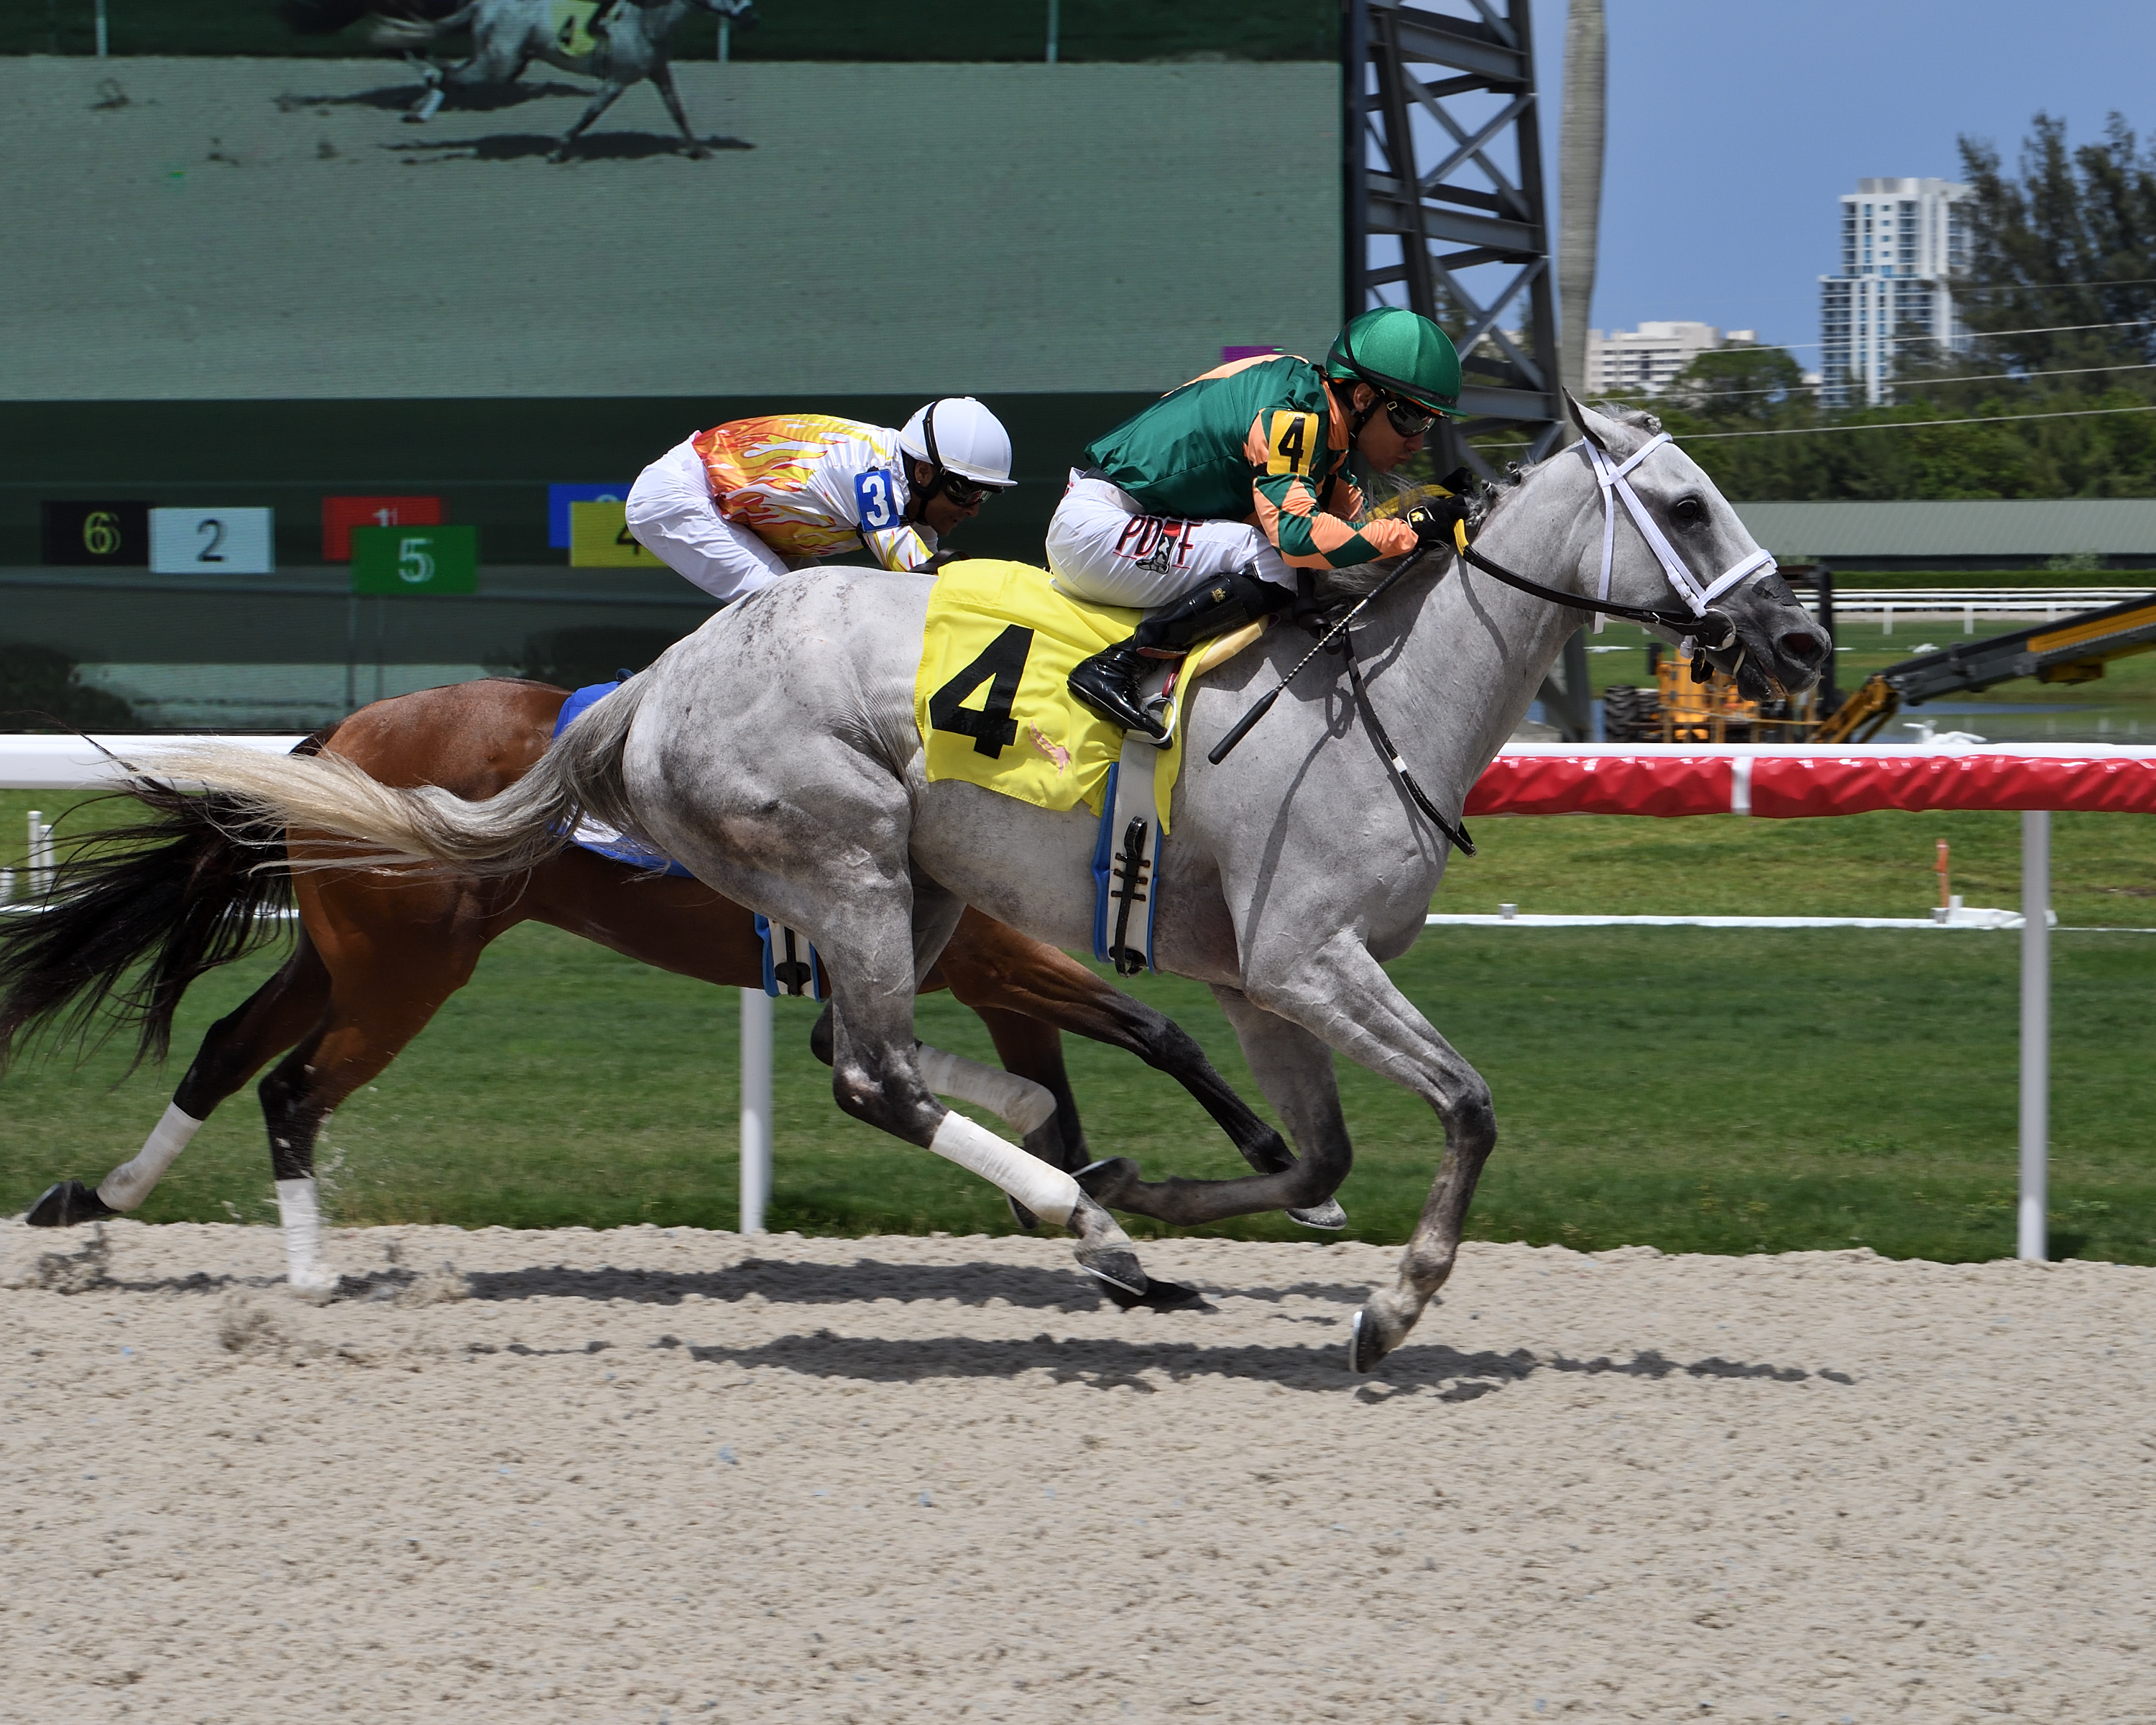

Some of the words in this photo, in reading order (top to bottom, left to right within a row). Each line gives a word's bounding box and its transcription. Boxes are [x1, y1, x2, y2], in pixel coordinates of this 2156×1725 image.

[1277, 416, 1306, 473] 4
[862, 474, 890, 527] 3
[83, 511, 119, 554] 6
[196, 518, 227, 562] 2
[398, 538, 434, 584] 5
[928, 623, 1035, 760] 4
